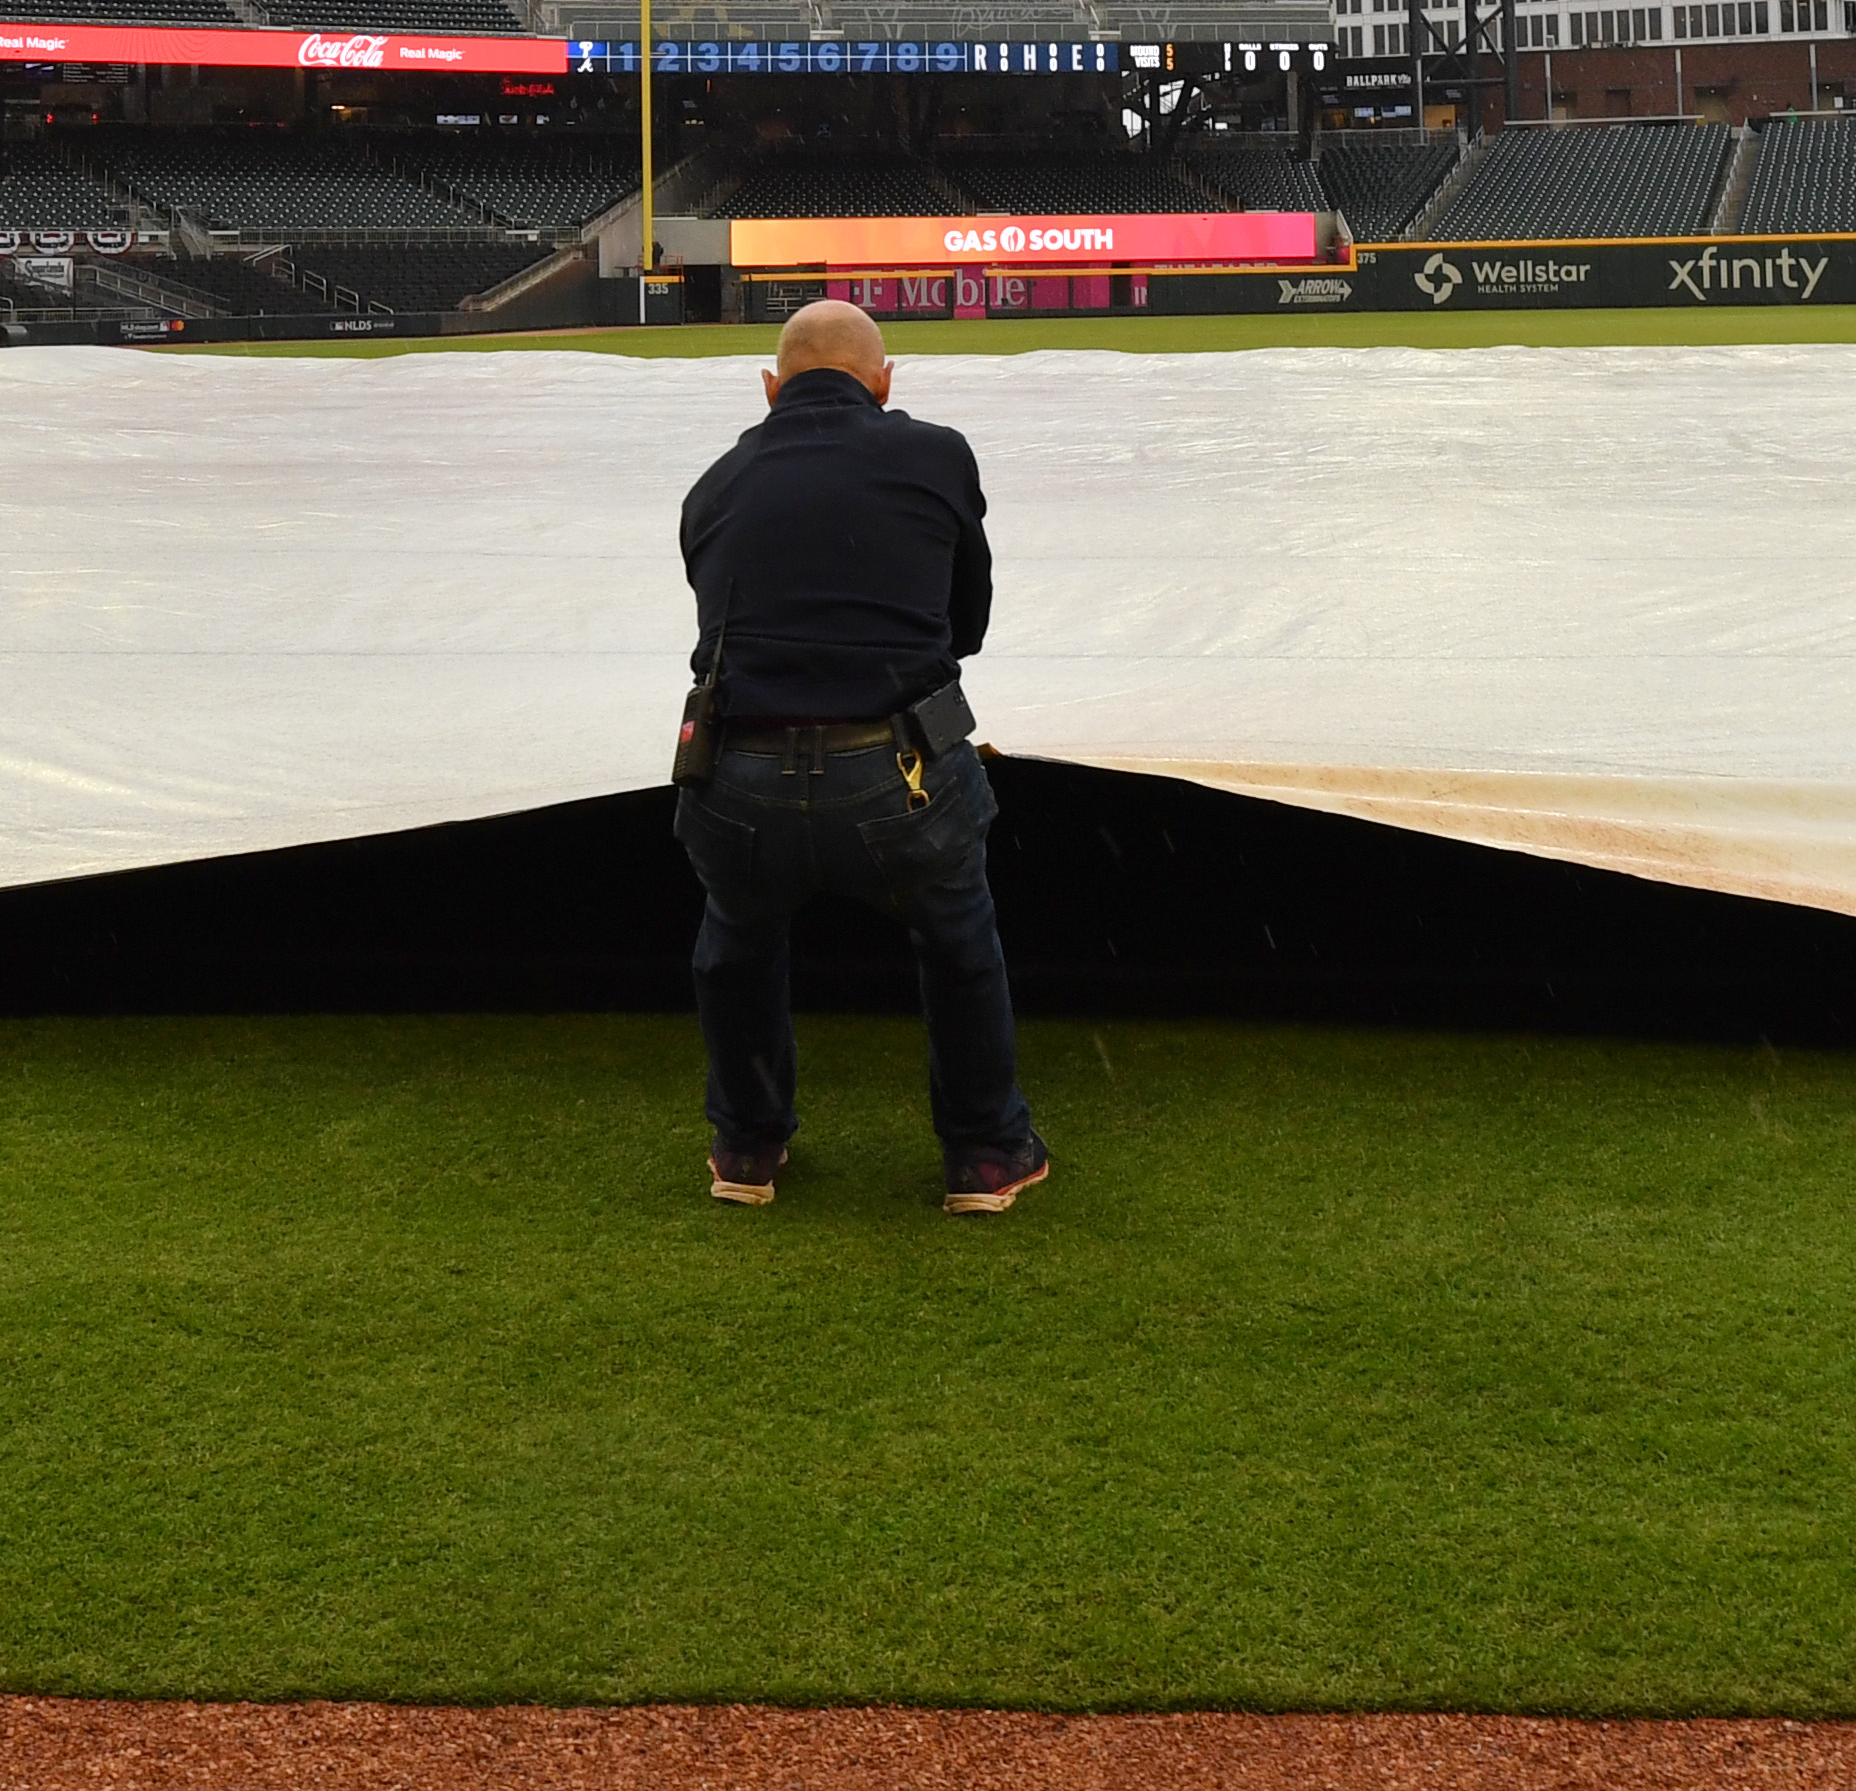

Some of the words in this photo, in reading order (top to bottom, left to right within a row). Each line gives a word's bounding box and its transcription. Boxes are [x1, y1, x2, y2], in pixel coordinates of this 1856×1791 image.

[26, 36, 66, 52] Magic
[298, 33, 389, 67] Coca-Cola
[400, 47, 427, 59] Real
[429, 48, 463, 62] Magic
[619, 43, 634, 72] 1
[656, 43, 680, 72] 2
[697, 43, 720, 72] 3
[737, 43, 761, 72] 4
[778, 43, 800, 72] 5
[817, 43, 840, 72] 6
[857, 43, 880, 72] 7
[897, 43, 919, 72] 8
[935, 43, 958, 72] 9
[974, 44, 987, 70] R
[1023, 44, 1036, 70] H
[1072, 44, 1083, 70] E
[1346, 74, 1397, 87] BALLPARK
[944, 230, 996, 252] GAS
[1029, 228, 1113, 250] SOUTH
[1357, 253, 1376, 264] 375
[1471, 260, 1590, 284] Wellstar
[1667, 246, 1829, 300] xfinity
[648, 283, 669, 295] 335
[900, 267, 1028, 308] Mobile
[1296, 279, 1340, 295] ARROW
[1477, 283, 1516, 293] HEALTH
[1520, 283, 1559, 293] SYSTEM
[345, 320, 372, 331] NLDS
